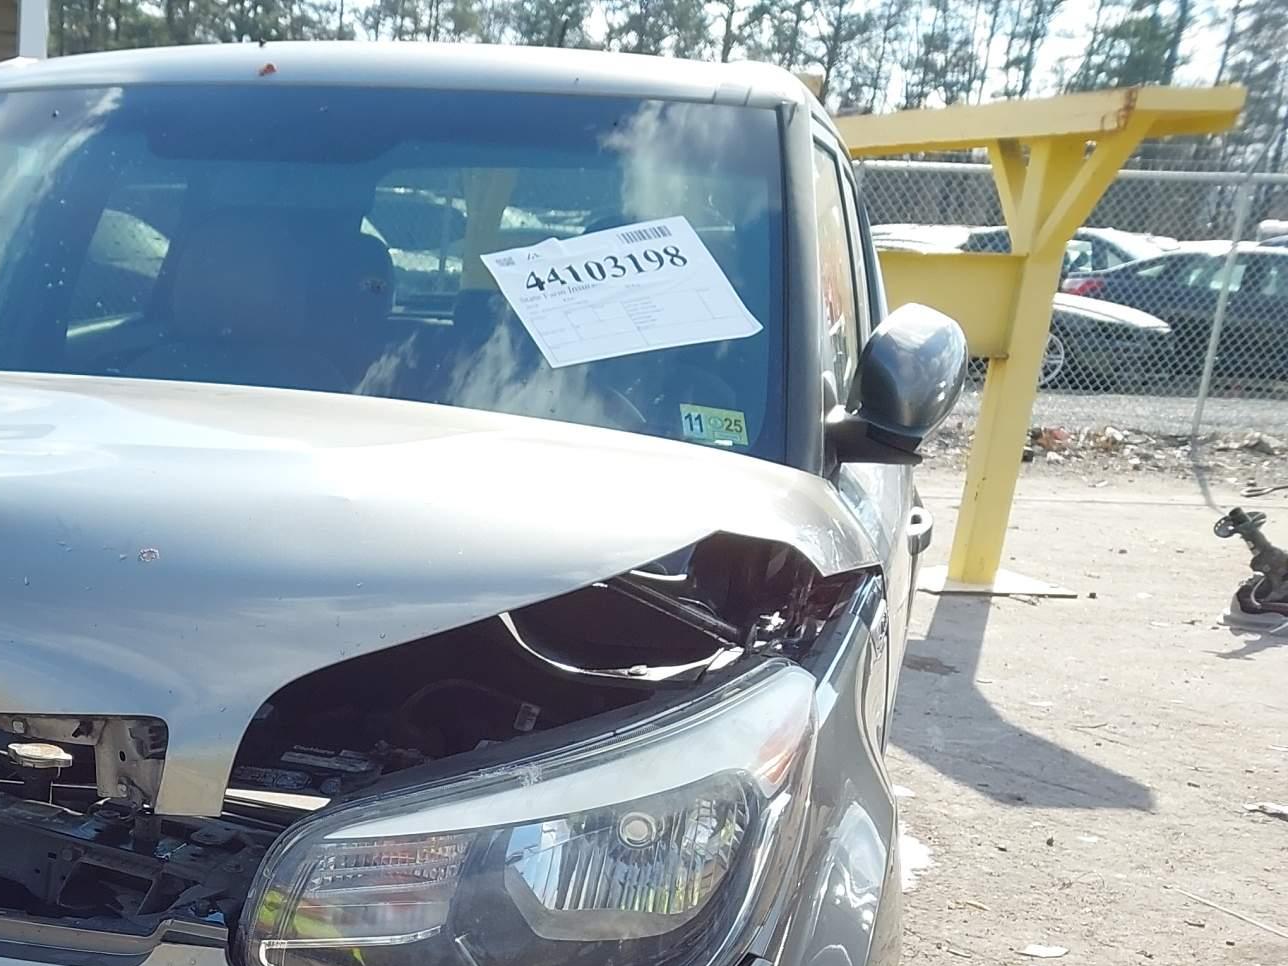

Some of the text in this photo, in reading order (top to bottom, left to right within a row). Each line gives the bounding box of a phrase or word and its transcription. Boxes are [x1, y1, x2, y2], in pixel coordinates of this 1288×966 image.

[526, 245, 688, 292] 44103198
[684, 412, 743, 433] 11 25
